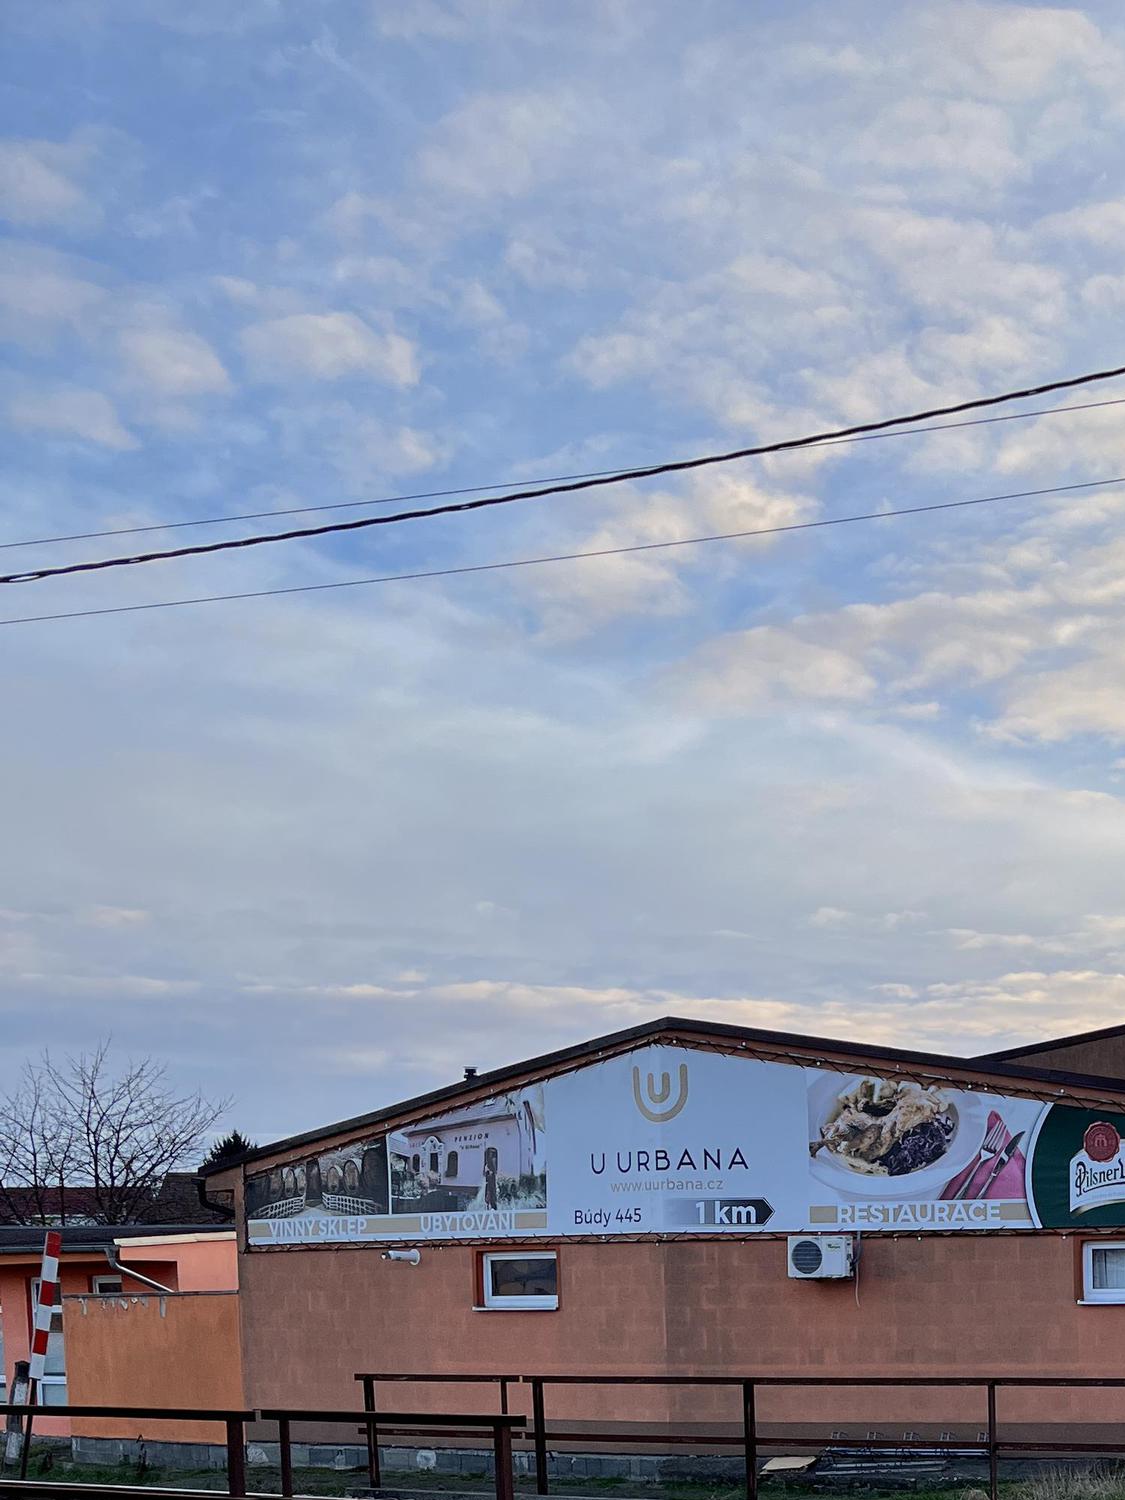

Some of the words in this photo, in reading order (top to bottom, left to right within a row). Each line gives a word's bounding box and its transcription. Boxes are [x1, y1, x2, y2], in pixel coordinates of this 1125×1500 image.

[590, 1152, 606, 1175] U
[616, 1147, 749, 1173] URBANA
[610, 1178, 724, 1193] www.uurbana.cz
[574, 1208, 611, 1228] Búdy
[615, 1207, 642, 1223] 445
[695, 1201, 706, 1224] 1
[714, 1200, 757, 1224] km
[837, 1201, 1001, 1224] RESTAURACE
[318, 1218, 367, 1237] SKLEP
